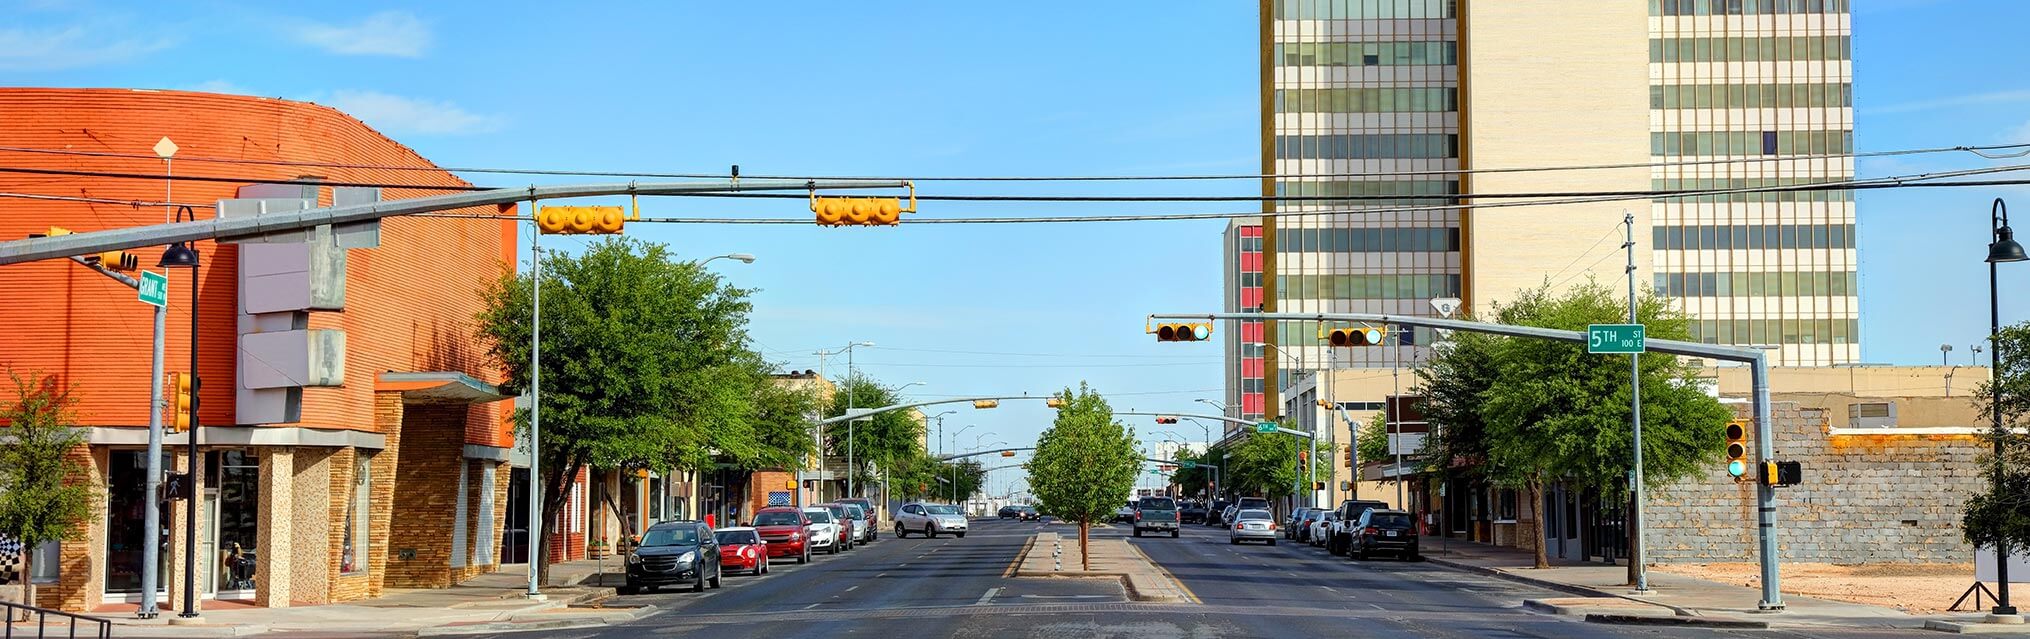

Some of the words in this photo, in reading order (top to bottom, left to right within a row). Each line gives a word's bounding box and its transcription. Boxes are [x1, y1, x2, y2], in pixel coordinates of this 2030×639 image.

[140, 276, 158, 298] GRANT
[1591, 330, 1617, 347] 5TH
[1632, 330, 1641, 338] ST
